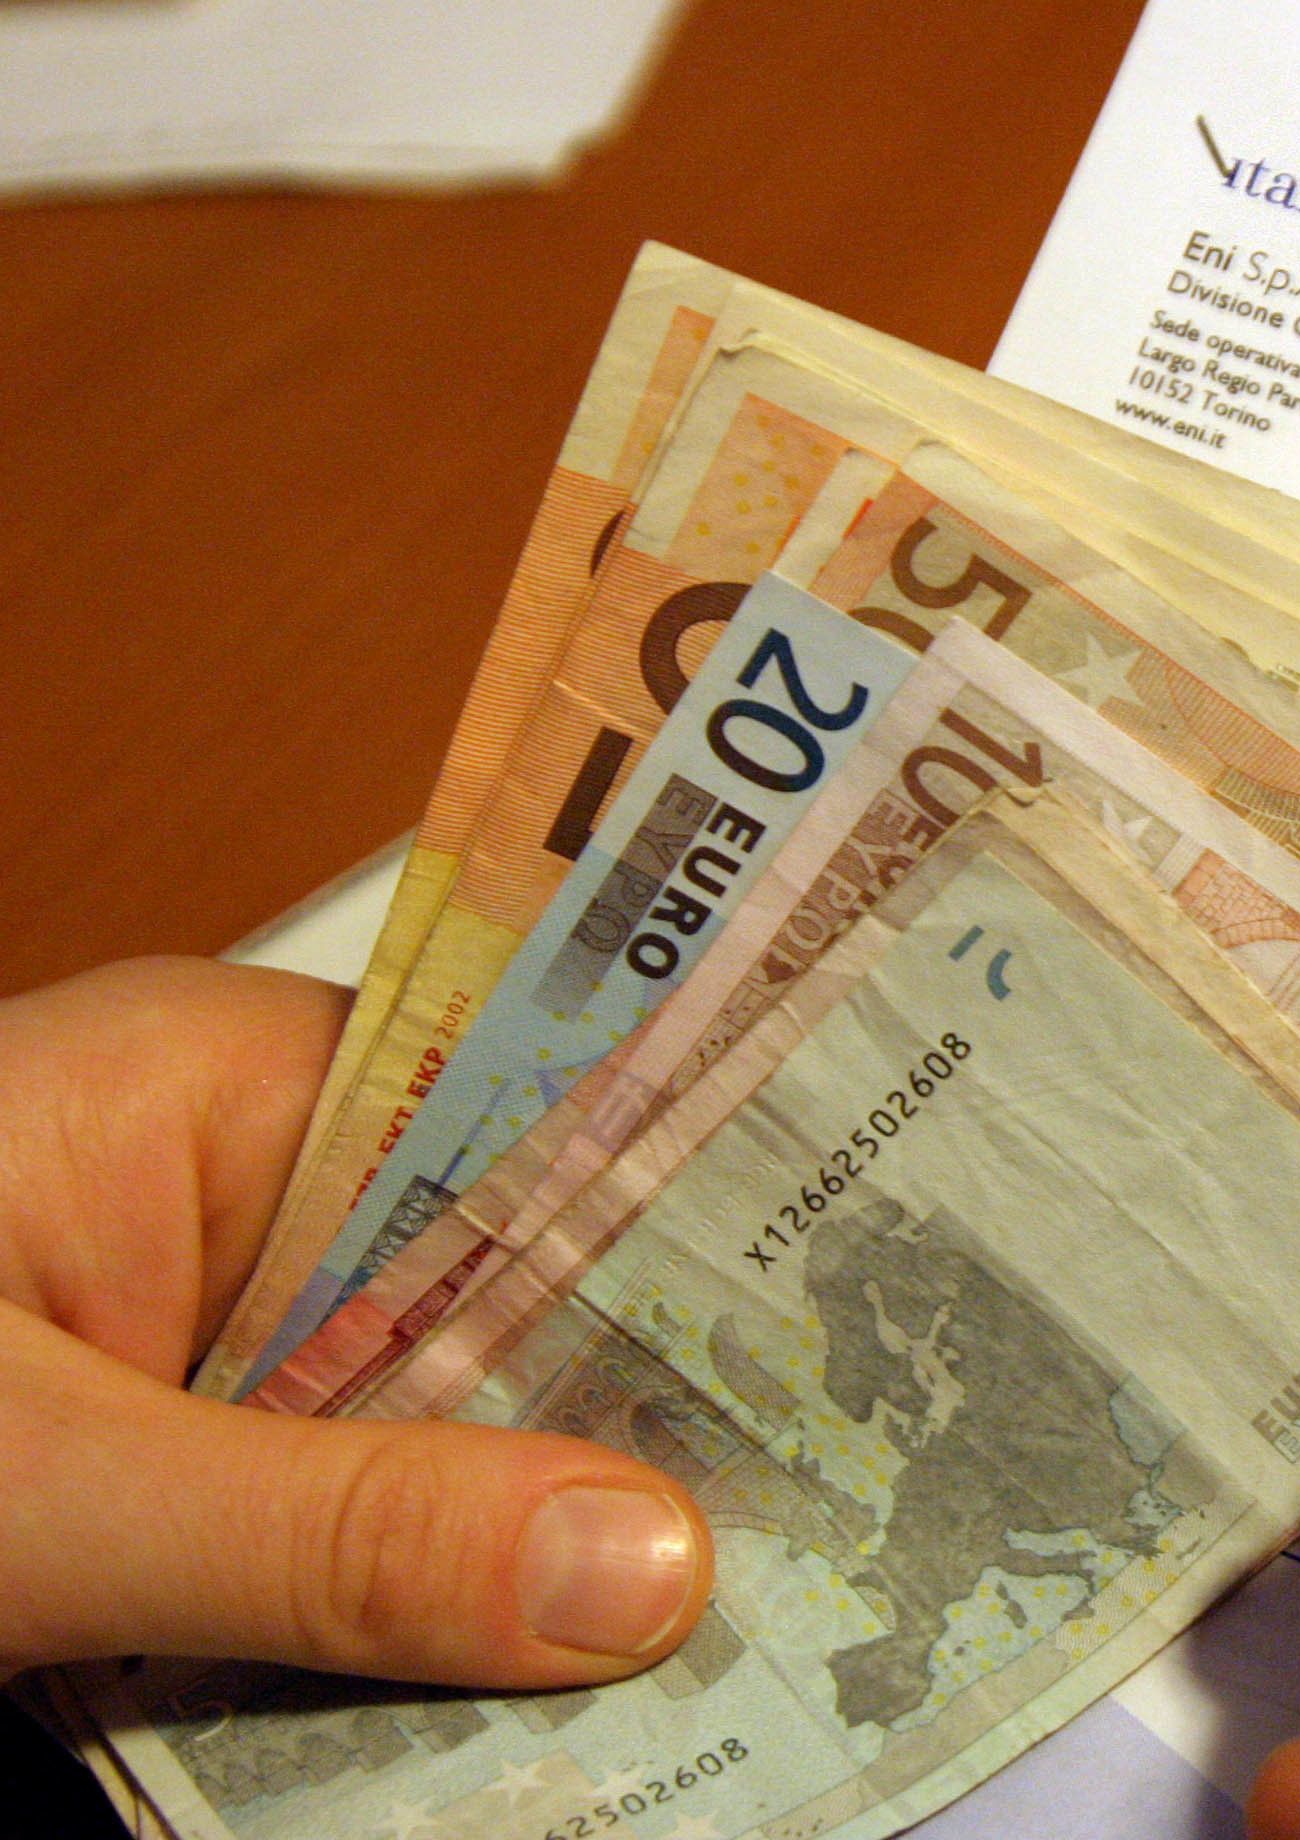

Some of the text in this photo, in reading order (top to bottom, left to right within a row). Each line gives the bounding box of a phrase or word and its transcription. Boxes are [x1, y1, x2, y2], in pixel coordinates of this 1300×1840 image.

[1182, 231, 1235, 272] Eni
[1150, 310, 1200, 342] Sede
[1167, 271, 1284, 329] Divisione
[1137, 338, 1195, 376] Largo
[1202, 359, 1261, 399] Regio
[1114, 399, 1227, 450] www.eni.it
[1129, 366, 1272, 432] 10152 Torino
[706, 627, 869, 793] 20
[626, 802, 766, 979] EURO
[436, 991, 471, 1040] 2002
[744, 1032, 972, 1272] X12662502608
